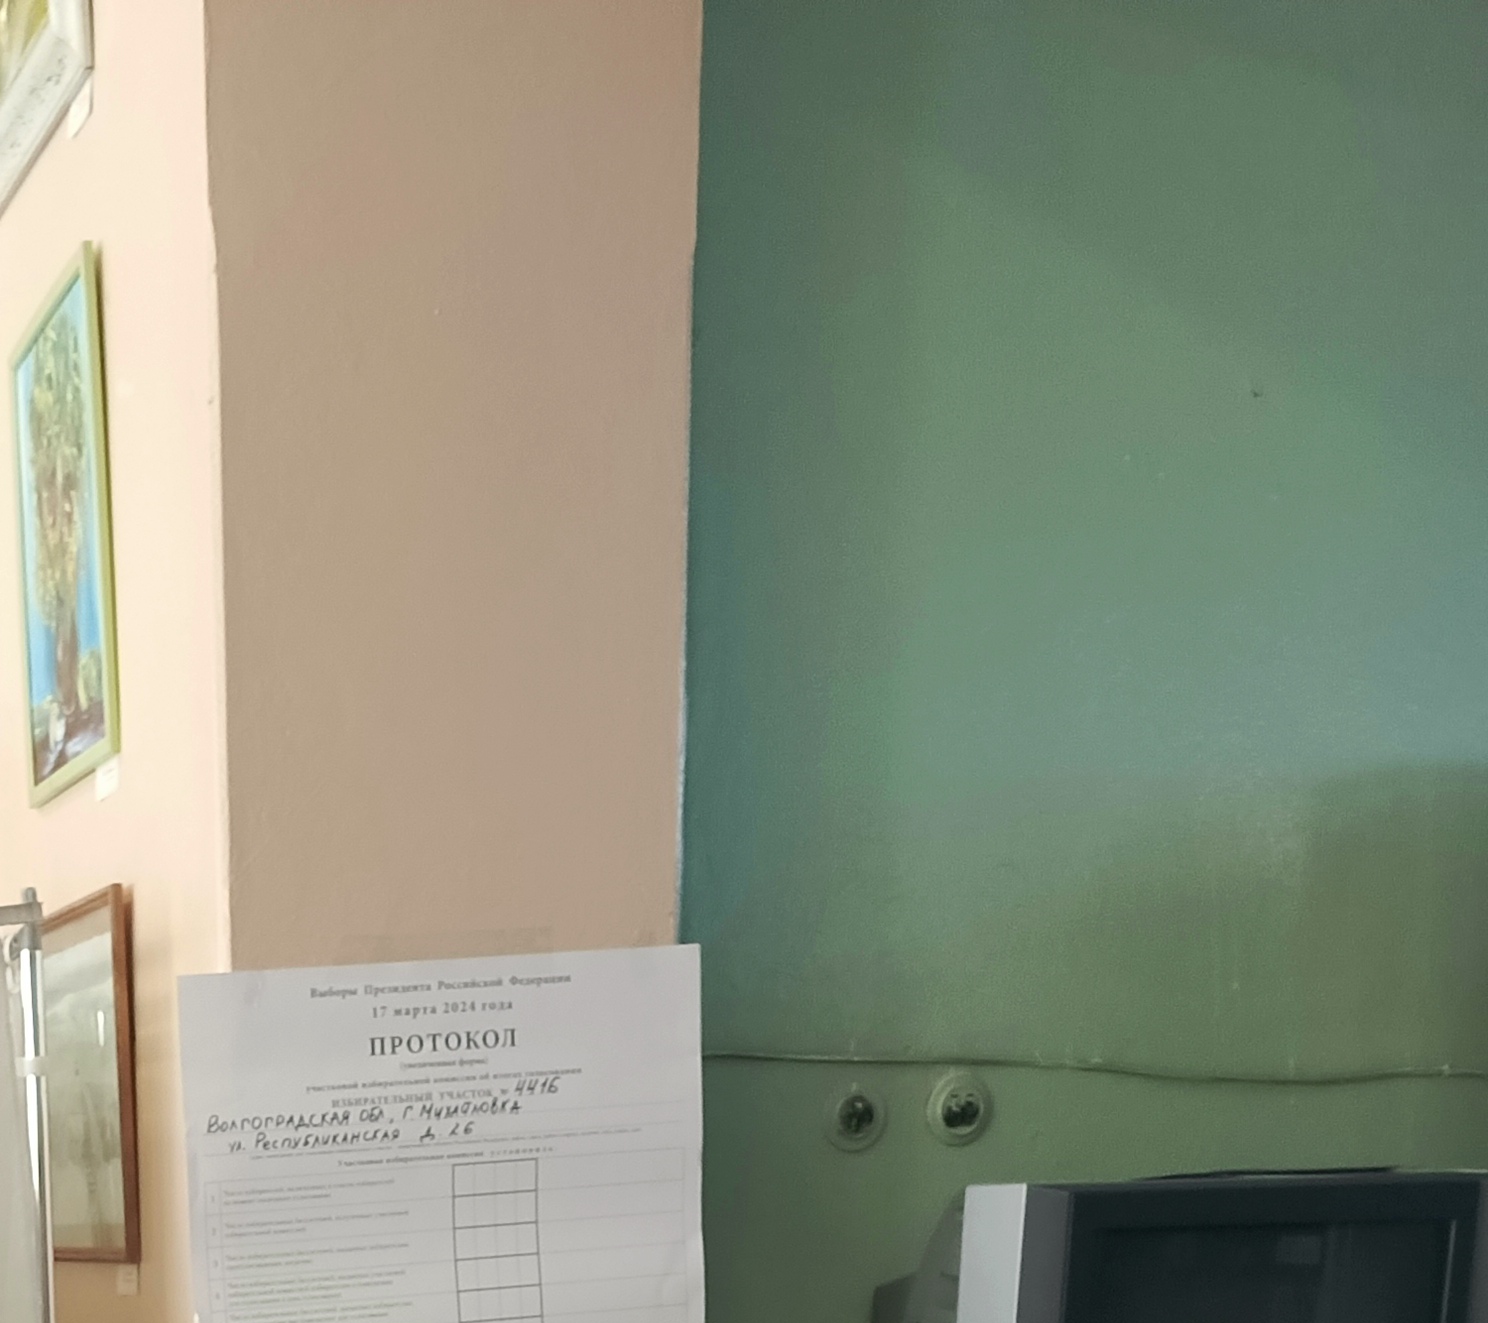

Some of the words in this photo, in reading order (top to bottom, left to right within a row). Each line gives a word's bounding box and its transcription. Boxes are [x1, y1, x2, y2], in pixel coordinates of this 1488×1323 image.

[372, 1005, 388, 1019] 17
[393, 1005, 437, 1020] марта
[443, 1000, 476, 1014] 2024
[481, 1000, 513, 1012] года
[369, 1028, 516, 1057] ПРОТОКОЛ
[513, 1076, 560, 1096] 4416
